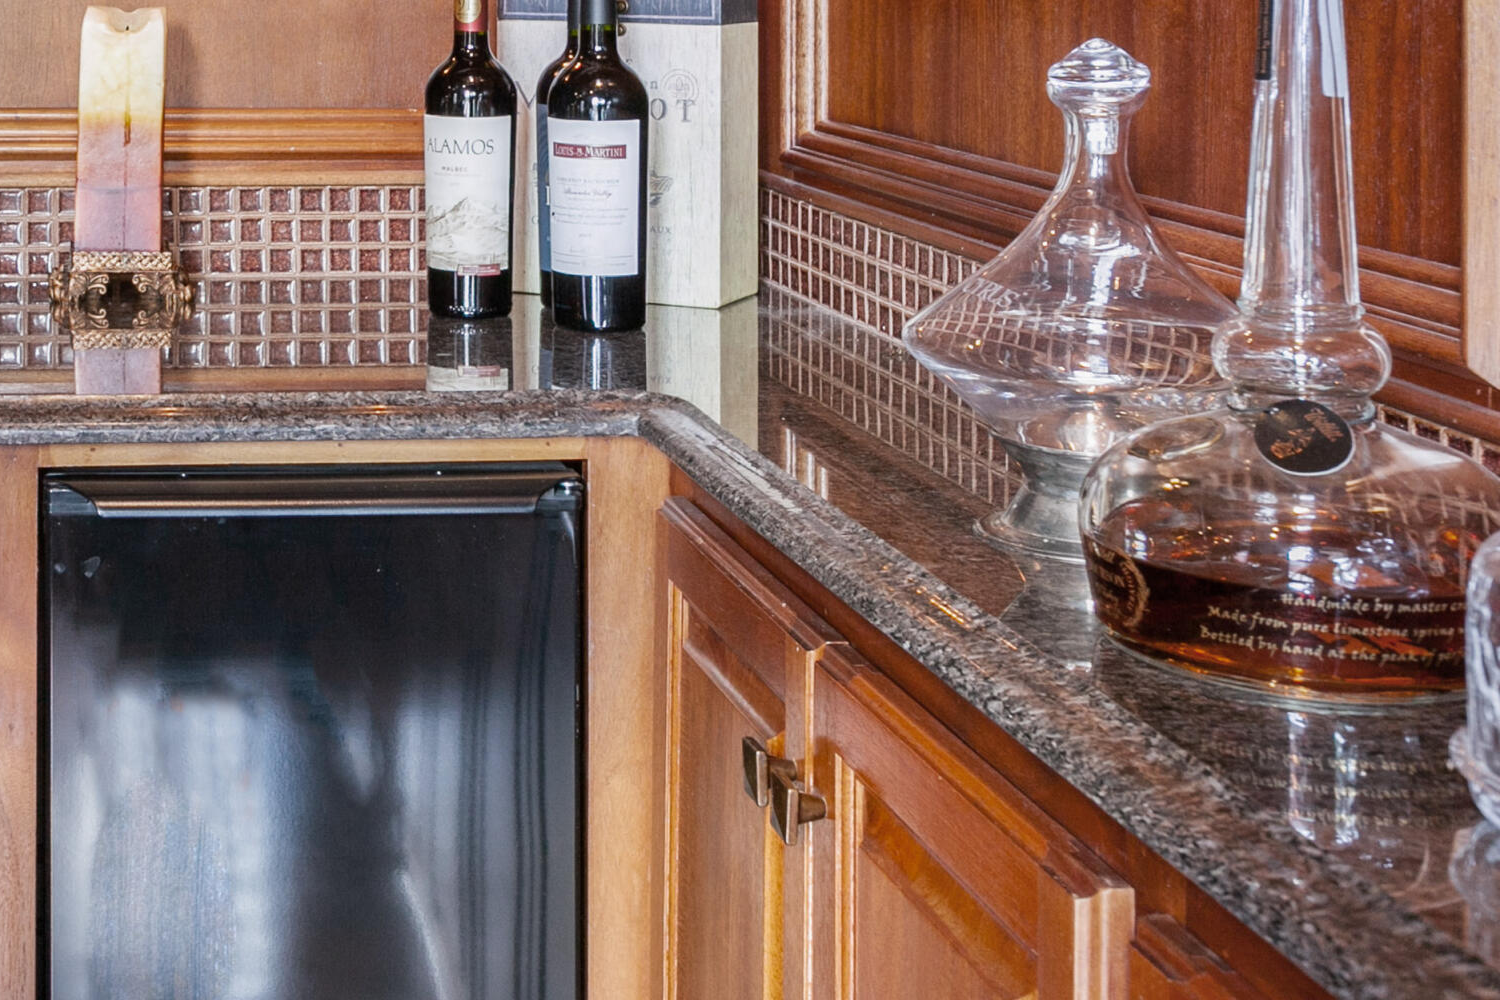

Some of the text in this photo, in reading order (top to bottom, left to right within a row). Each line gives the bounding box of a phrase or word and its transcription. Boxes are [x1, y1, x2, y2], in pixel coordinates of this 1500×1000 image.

[426, 137, 495, 156] ALAMOS
[1373, 597, 1394, 620] by
[1207, 604, 1249, 626] Made
[1249, 611, 1288, 631] from
[1290, 621, 1330, 637] pure
[1281, 639, 1324, 661] hand
